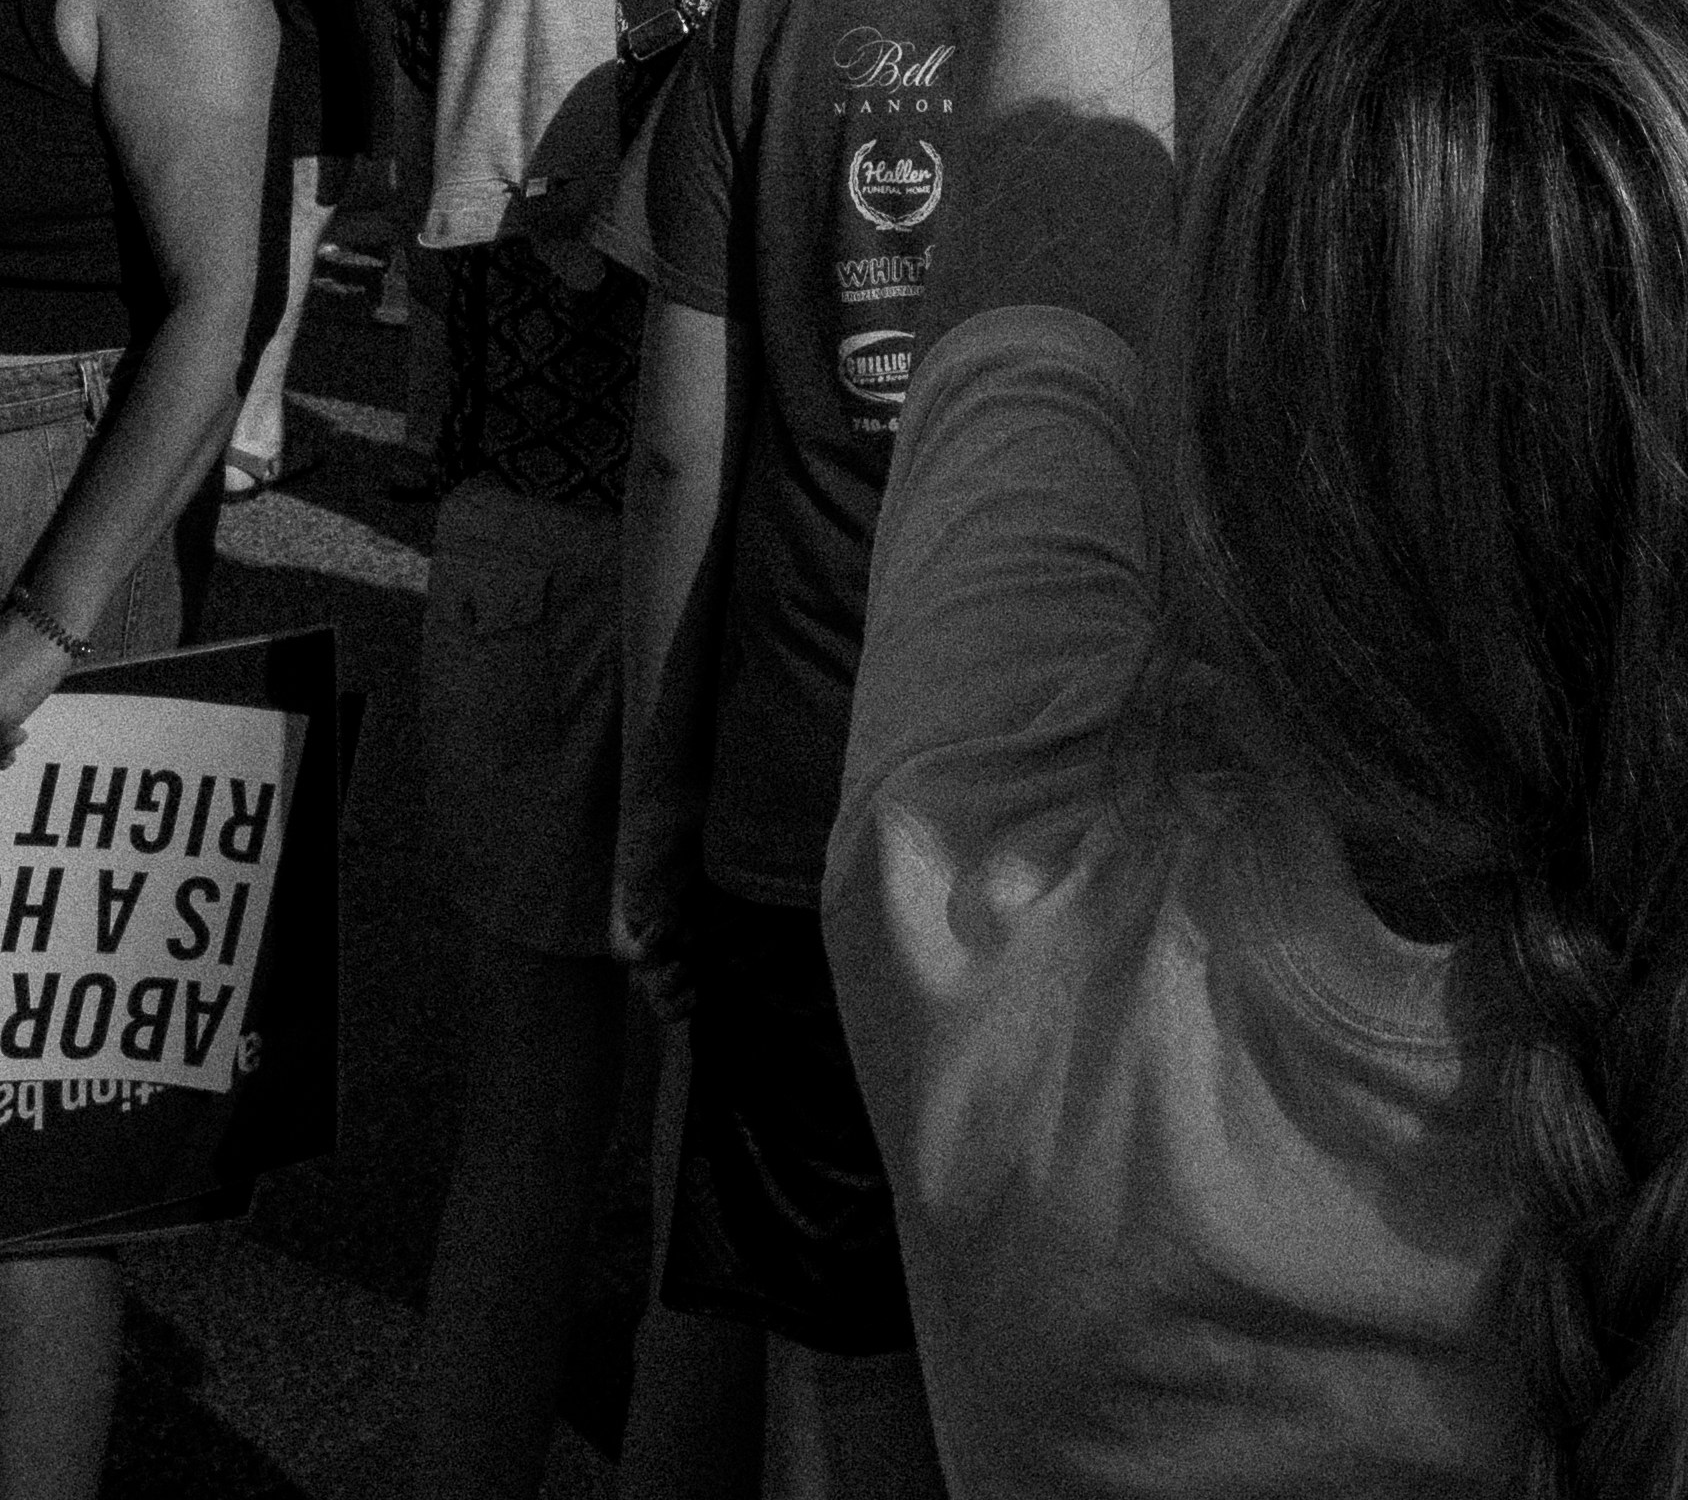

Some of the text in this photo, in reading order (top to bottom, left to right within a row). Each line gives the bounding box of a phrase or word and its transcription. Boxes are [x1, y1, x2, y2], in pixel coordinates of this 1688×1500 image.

[833, 26, 955, 94] Bell
[834, 98, 953, 114] MANOR
[863, 158, 932, 184] Haller
[14, 763, 276, 864] RIGHT
[96, 869, 148, 954] A
[167, 876, 251, 966] IS
[0, 973, 235, 1067] ABOR
